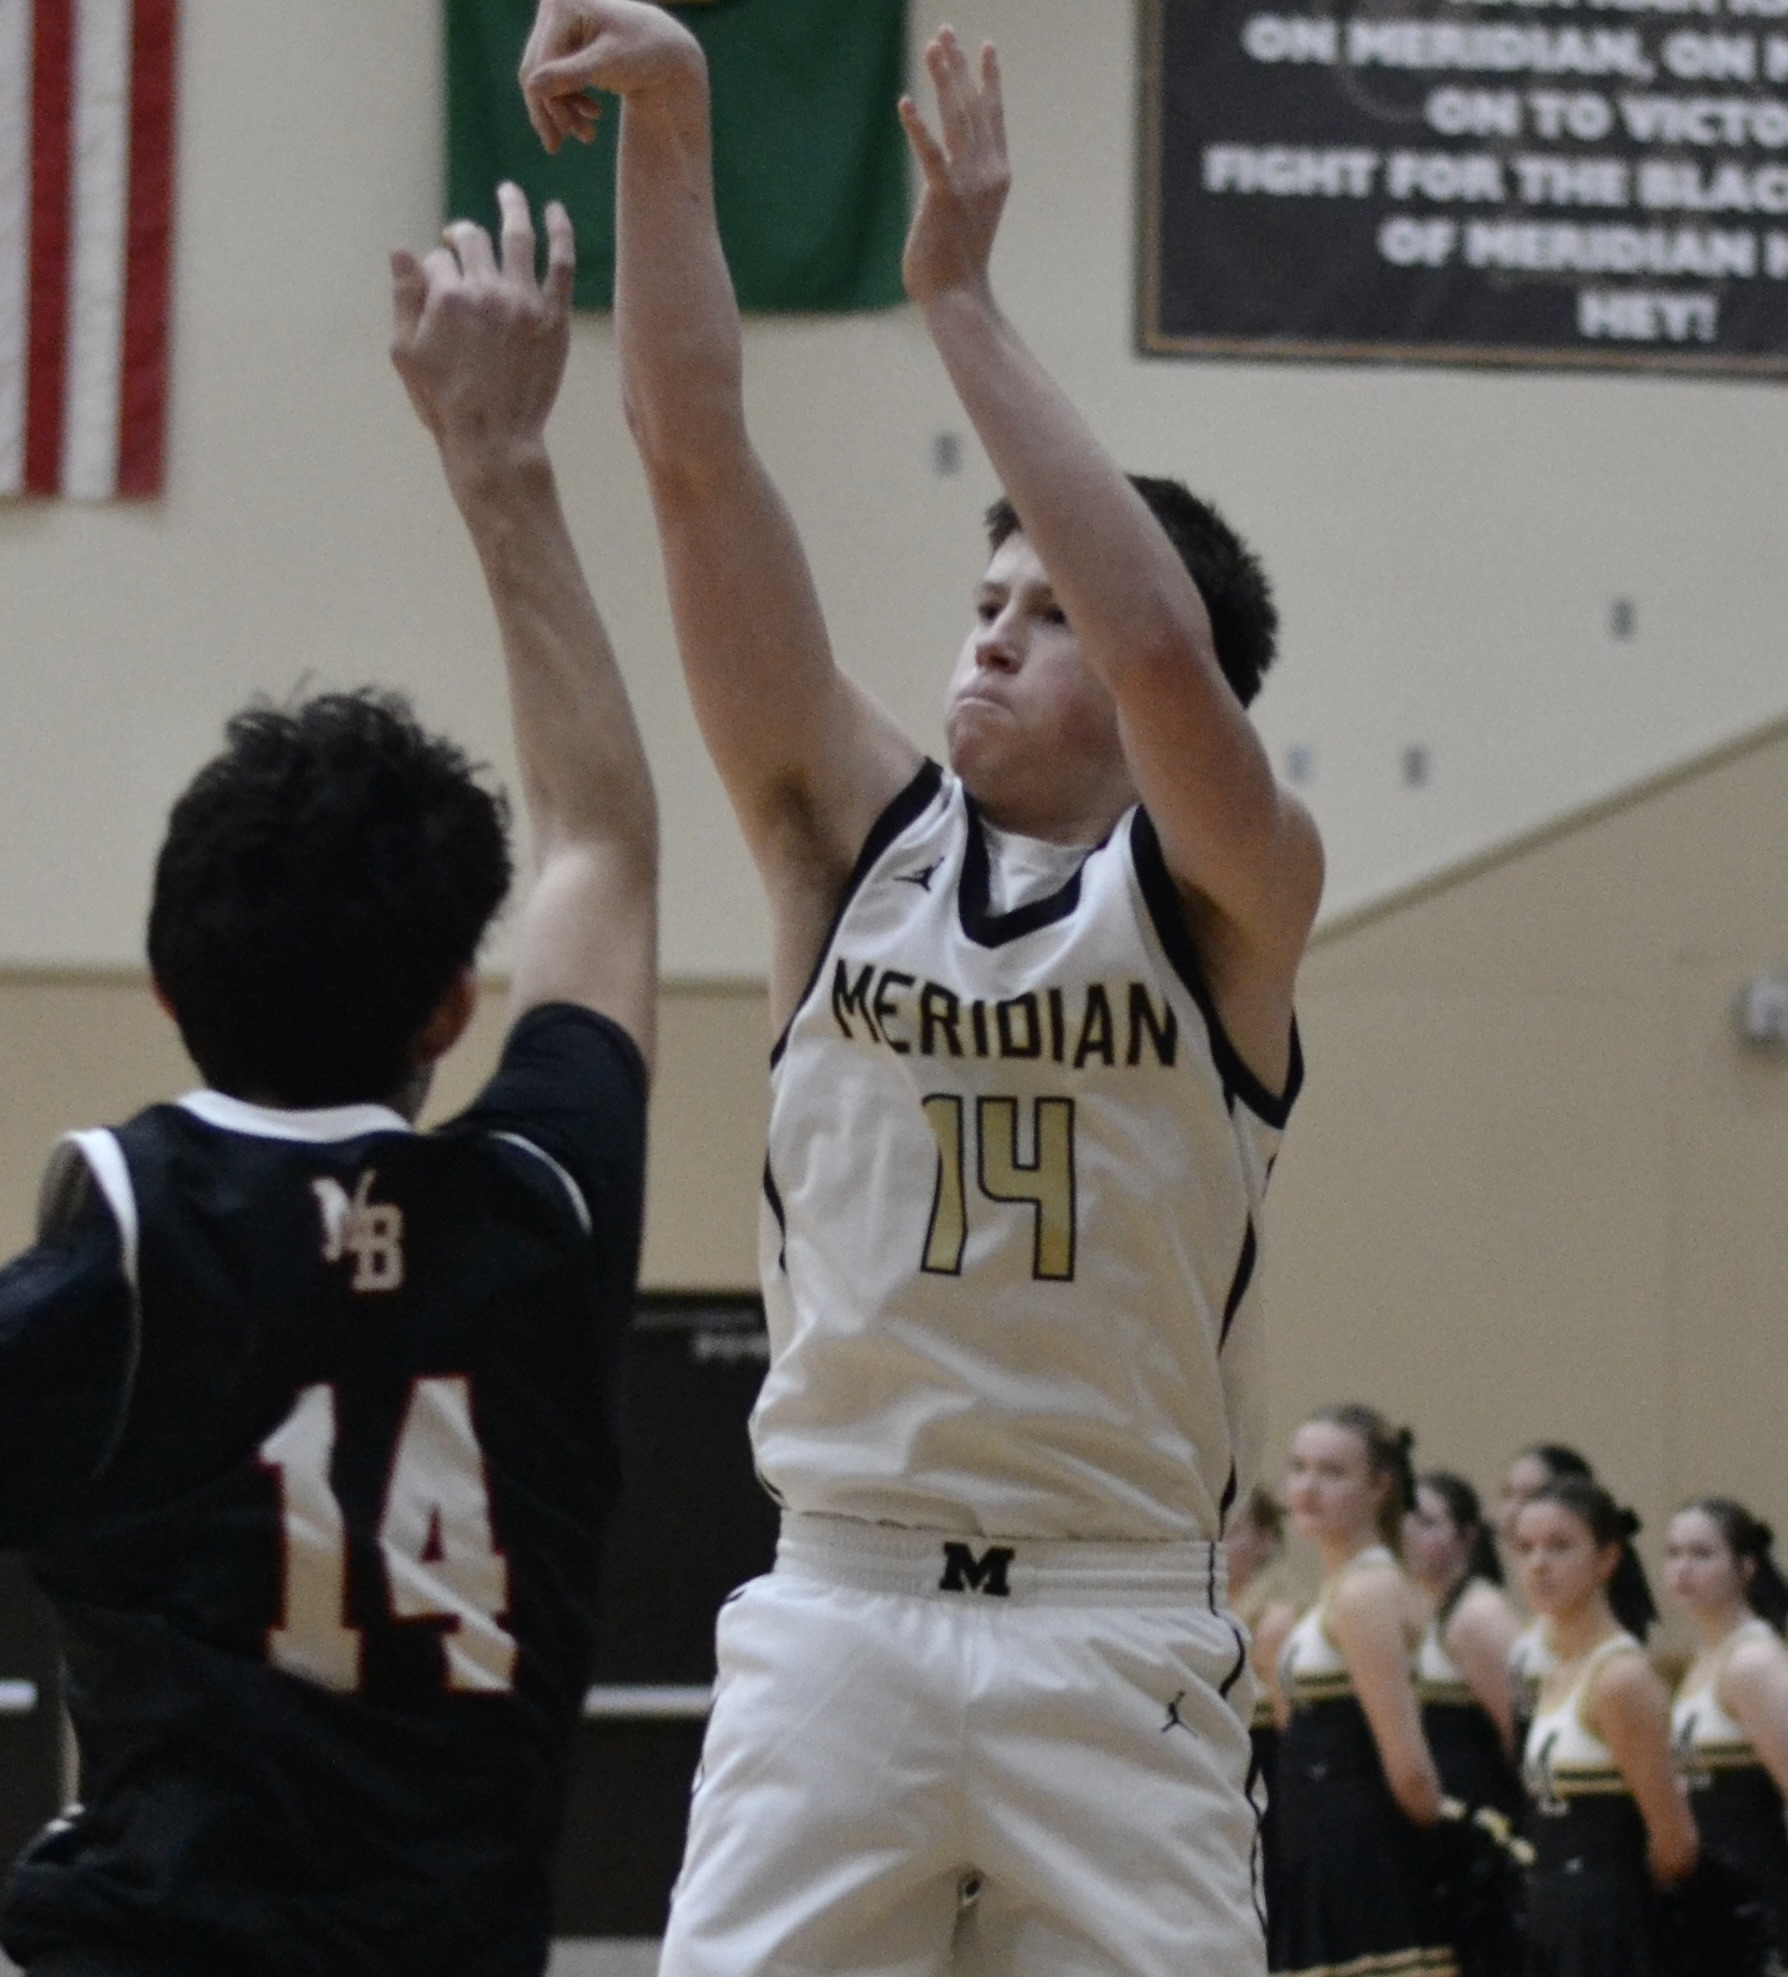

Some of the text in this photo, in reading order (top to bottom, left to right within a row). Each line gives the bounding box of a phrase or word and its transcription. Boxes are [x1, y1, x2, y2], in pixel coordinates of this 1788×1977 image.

[1242, 14, 1340, 64] ON
[1662, 30, 1756, 80] ON
[1424, 87, 1521, 137] ON
[1530, 92, 1612, 140] TO
[1203, 145, 1379, 197] FIGHT
[1385, 150, 1504, 202] FOR
[1513, 155, 1629, 207] THE
[1377, 217, 1457, 267] OF
[1463, 219, 1756, 278] MERIDIAN
[1577, 291, 1718, 342] HEY!
[832, 958, 1180, 1069] MERIDIAN
[920, 1093, 1076, 1282] 14
[256, 1373, 520, 1695] 14
[939, 1541, 1015, 1597] M
